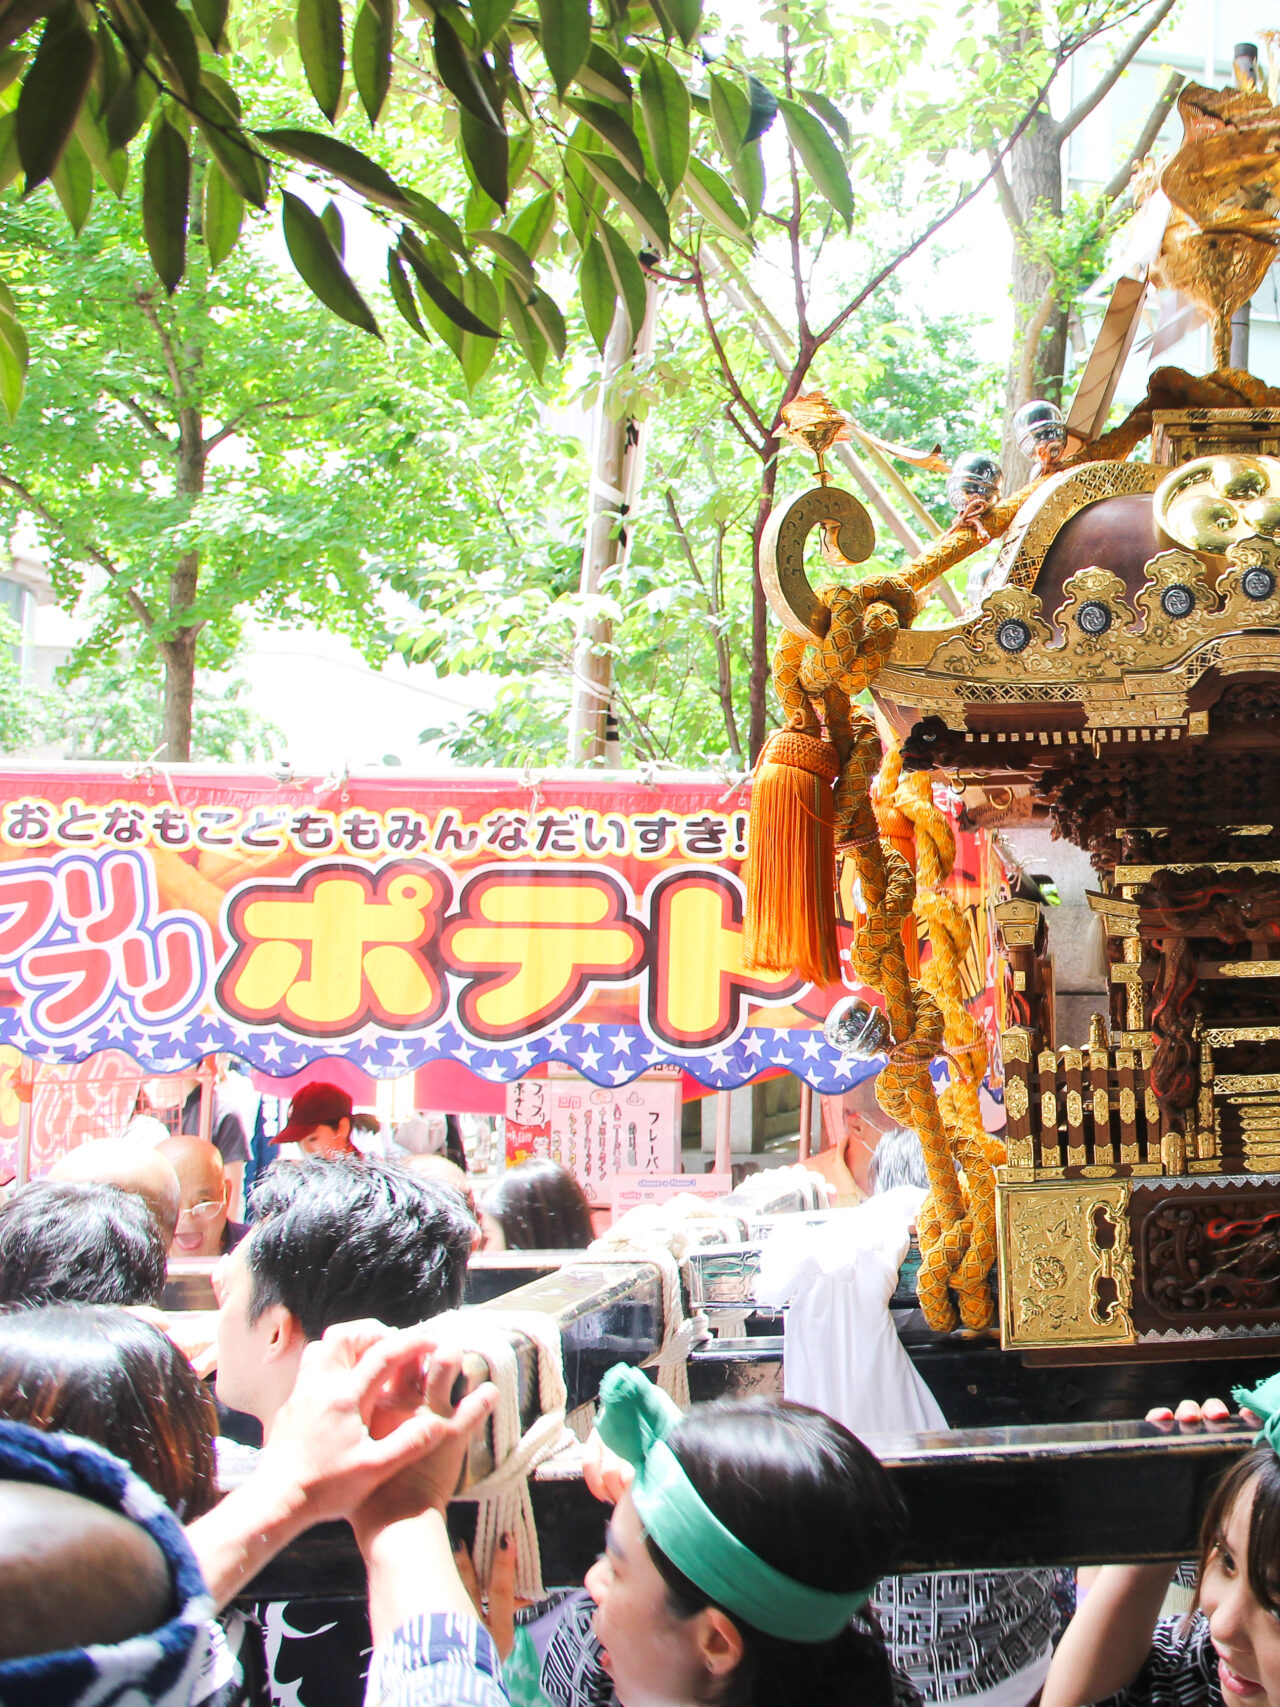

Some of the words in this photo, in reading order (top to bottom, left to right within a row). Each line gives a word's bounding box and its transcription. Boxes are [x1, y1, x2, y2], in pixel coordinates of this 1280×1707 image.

[7, 802, 747, 856] おとなもこどももみんなだいすき!
[226, 869, 800, 1040] ポテト
[646, 1112, 660, 1174] フレーバ
